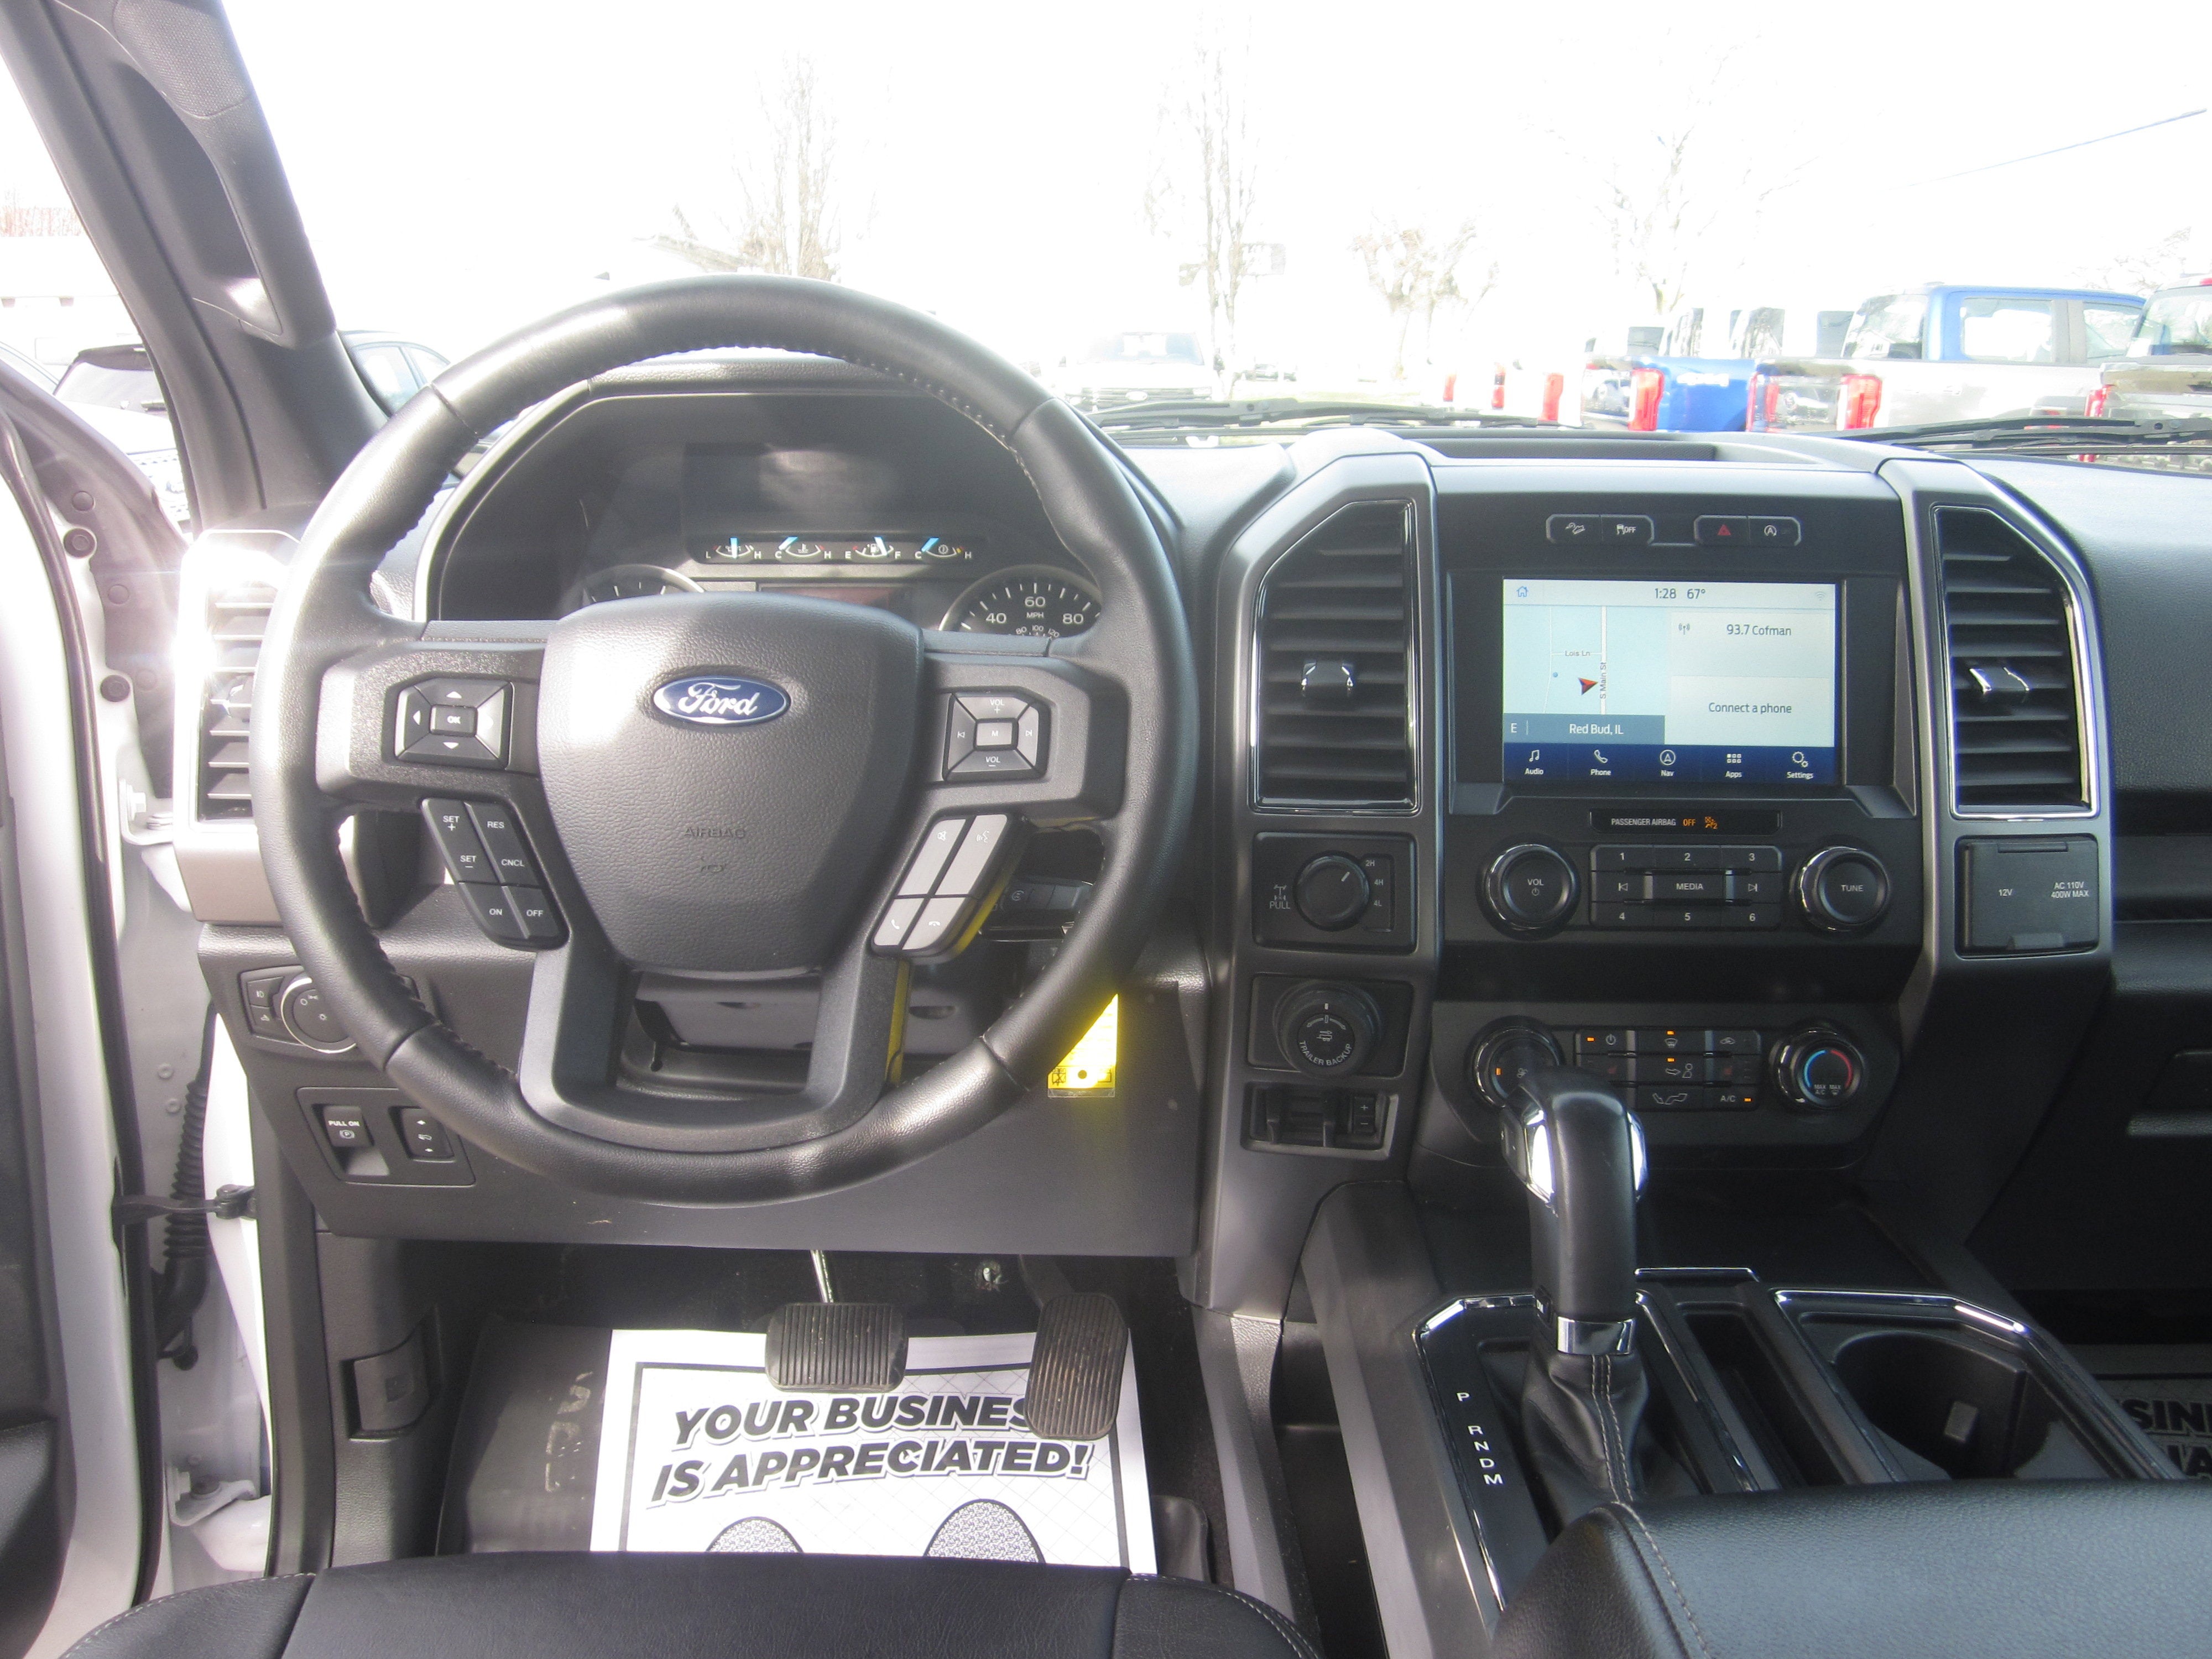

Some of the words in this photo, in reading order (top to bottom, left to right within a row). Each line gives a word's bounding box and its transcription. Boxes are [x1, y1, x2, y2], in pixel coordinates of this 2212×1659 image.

[1624, 525, 1636, 534] OFF
[1654, 588, 1676, 599] 1:28
[1687, 588, 1705, 599] 67°
[1025, 596, 1046, 608] 60
[986, 612, 1006, 624] 40
[1062, 613, 1084, 624] 80
[1047, 628, 1060, 638] 120
[1726, 624, 1750, 635] 93.7
[1752, 624, 1791, 637] Cofman
[1600, 662, 1606, 671] St
[678, 682, 760, 716] Ford
[1708, 702, 1750, 714] Connect
[1752, 705, 1758, 713] a
[1760, 702, 1791, 717] phone
[447, 716, 460, 724] OK
[1511, 723, 1517, 733] E
[1569, 723, 1589, 734] Red
[1591, 723, 1613, 736] Bud,
[1614, 724, 1624, 735] IL
[1525, 767, 1543, 775] Audio
[1590, 767, 1611, 776] Phone
[1725, 770, 1742, 779] Apps
[1787, 771, 1813, 780] Settings
[1611, 817, 1651, 826] PASSENGER
[1652, 817, 1676, 826] AIRBAG
[1683, 818, 1696, 826] OFF
[685, 827, 746, 839] AIRBAG
[501, 859, 524, 867] CNCL
[1300, 1041, 1324, 1066] TRAILER
[1326, 1044, 1352, 1066] BACKUP
[1456, 1392, 1470, 1401] P
[675, 1400, 815, 1444] YOUR
[1467, 1426, 1483, 1435] R
[1474, 1441, 1490, 1451] N
[1479, 1458, 1495, 1468] D
[651, 1460, 704, 1502] IS
[710, 1441, 1091, 1492] APPRECIATED!
[1483, 1474, 1504, 1485] M
